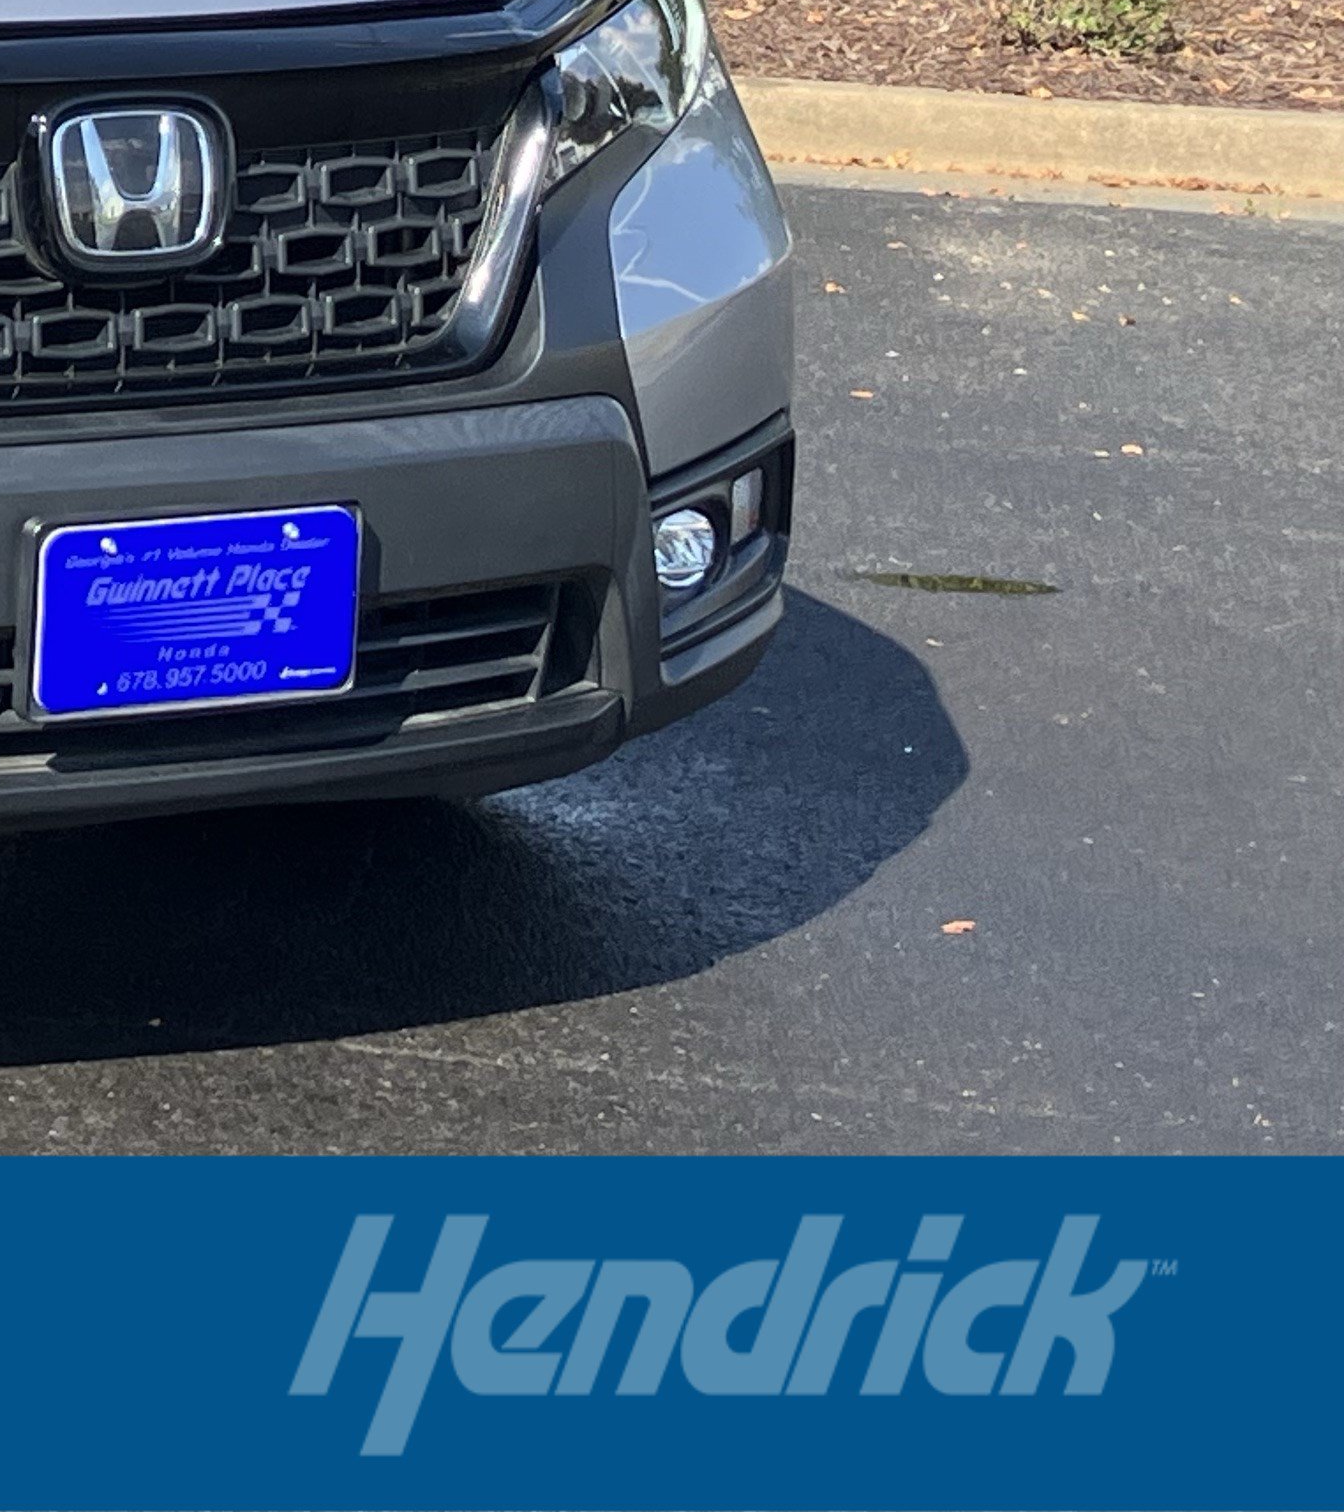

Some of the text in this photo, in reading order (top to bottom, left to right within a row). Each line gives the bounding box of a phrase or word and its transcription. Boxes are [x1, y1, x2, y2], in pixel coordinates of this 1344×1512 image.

[86, 562, 312, 607] Gwinnett Place
[157, 643, 231, 663] Honda
[115, 659, 267, 693] 678.957.5000
